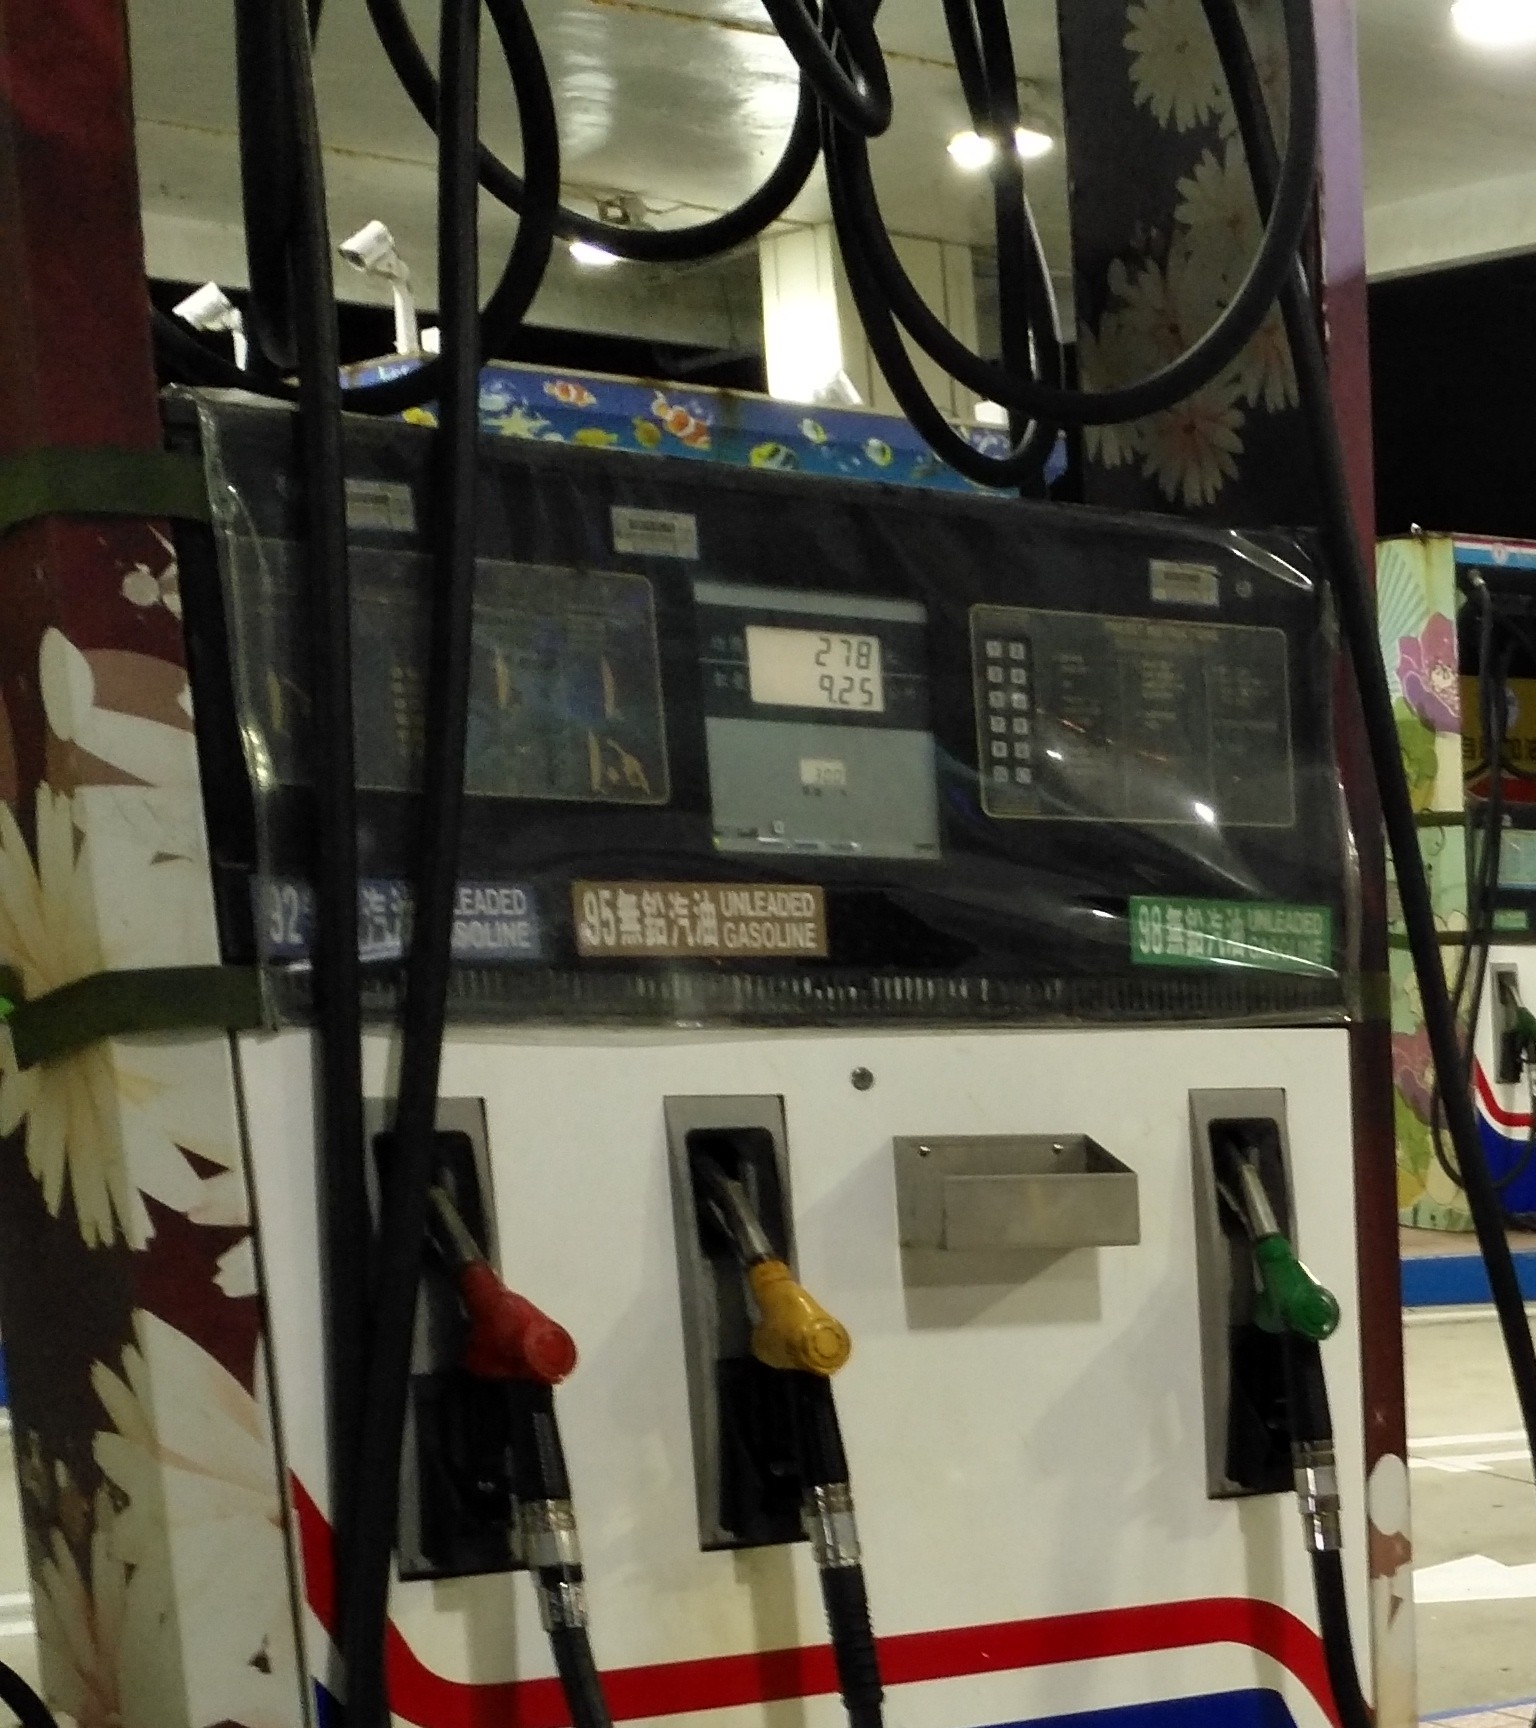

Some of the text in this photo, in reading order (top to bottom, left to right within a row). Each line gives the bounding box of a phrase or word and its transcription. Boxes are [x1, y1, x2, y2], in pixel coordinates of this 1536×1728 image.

[813, 636, 873, 670] 278
[719, 890, 816, 918] UNLEADED
[723, 921, 818, 949] GASOLINE
